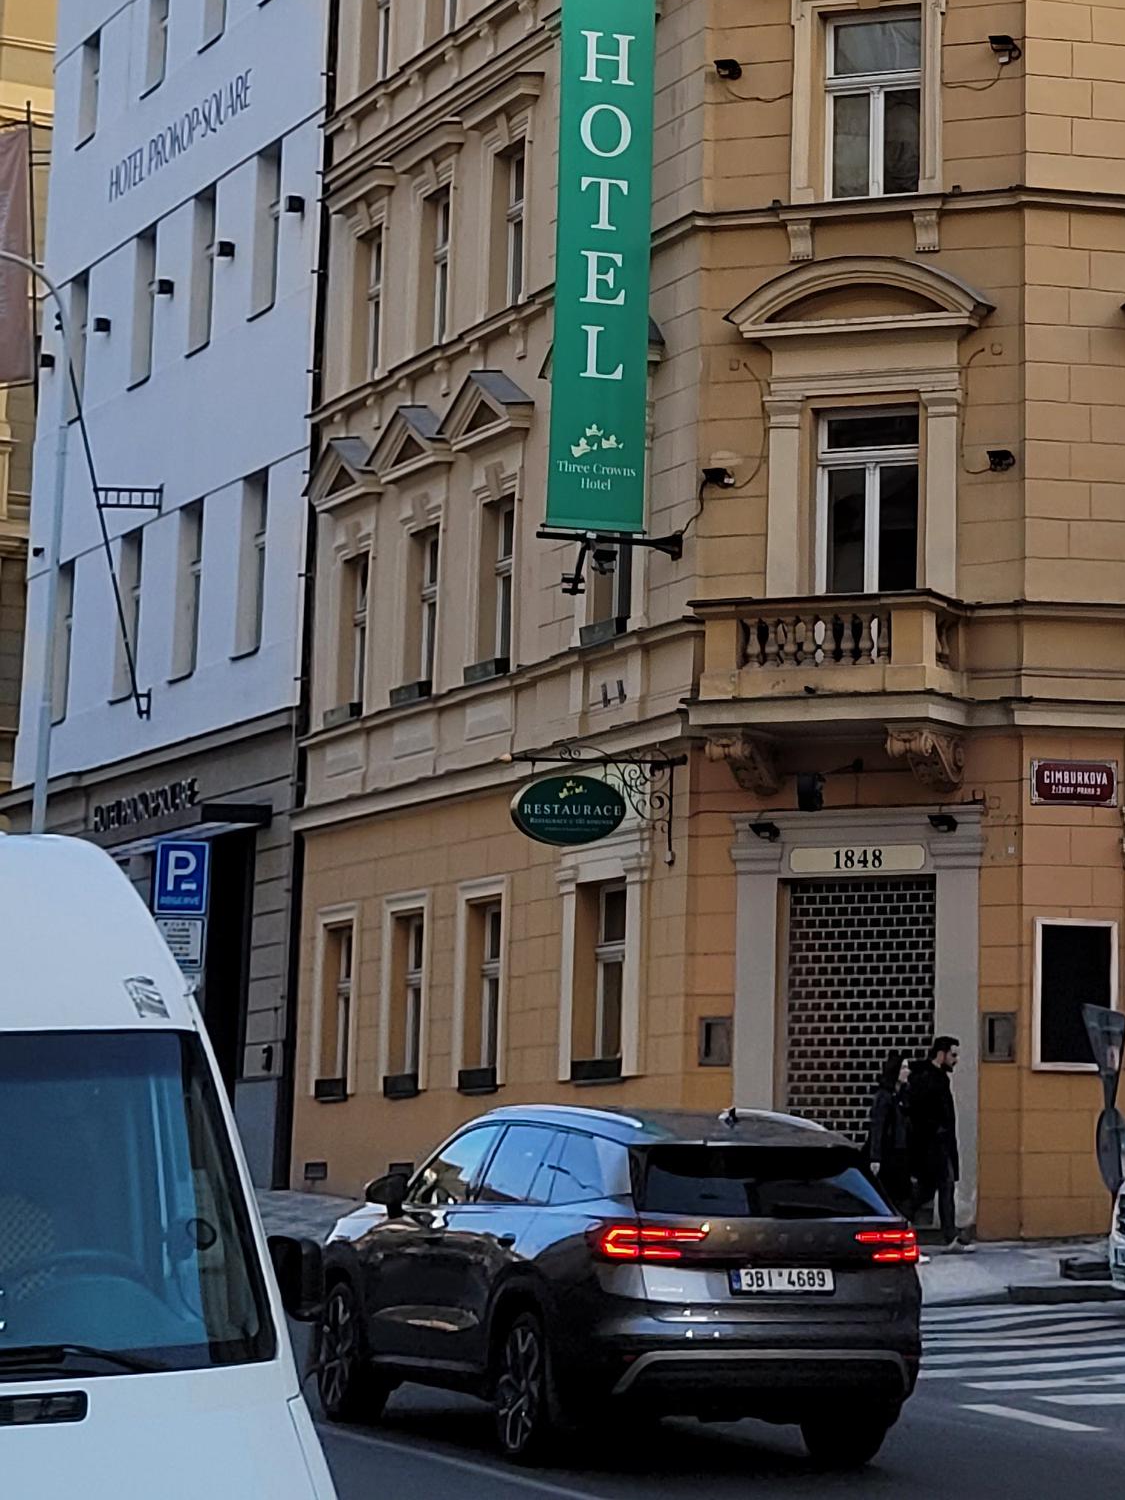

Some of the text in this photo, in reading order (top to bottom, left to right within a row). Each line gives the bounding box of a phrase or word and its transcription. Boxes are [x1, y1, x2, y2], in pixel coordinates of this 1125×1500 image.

[108, 147, 145, 202] HOTEL
[579, 30, 636, 381] HOTEL
[557, 460, 636, 477] Three Crowns
[581, 477, 612, 491] Hotel
[1044, 770, 1108, 785] CIMBURKOVA
[523, 803, 622, 817] RESTAURACE
[833, 848, 883, 870] 1848
[166, 850, 197, 891] P
[787, 1270, 826, 1288] 4689
